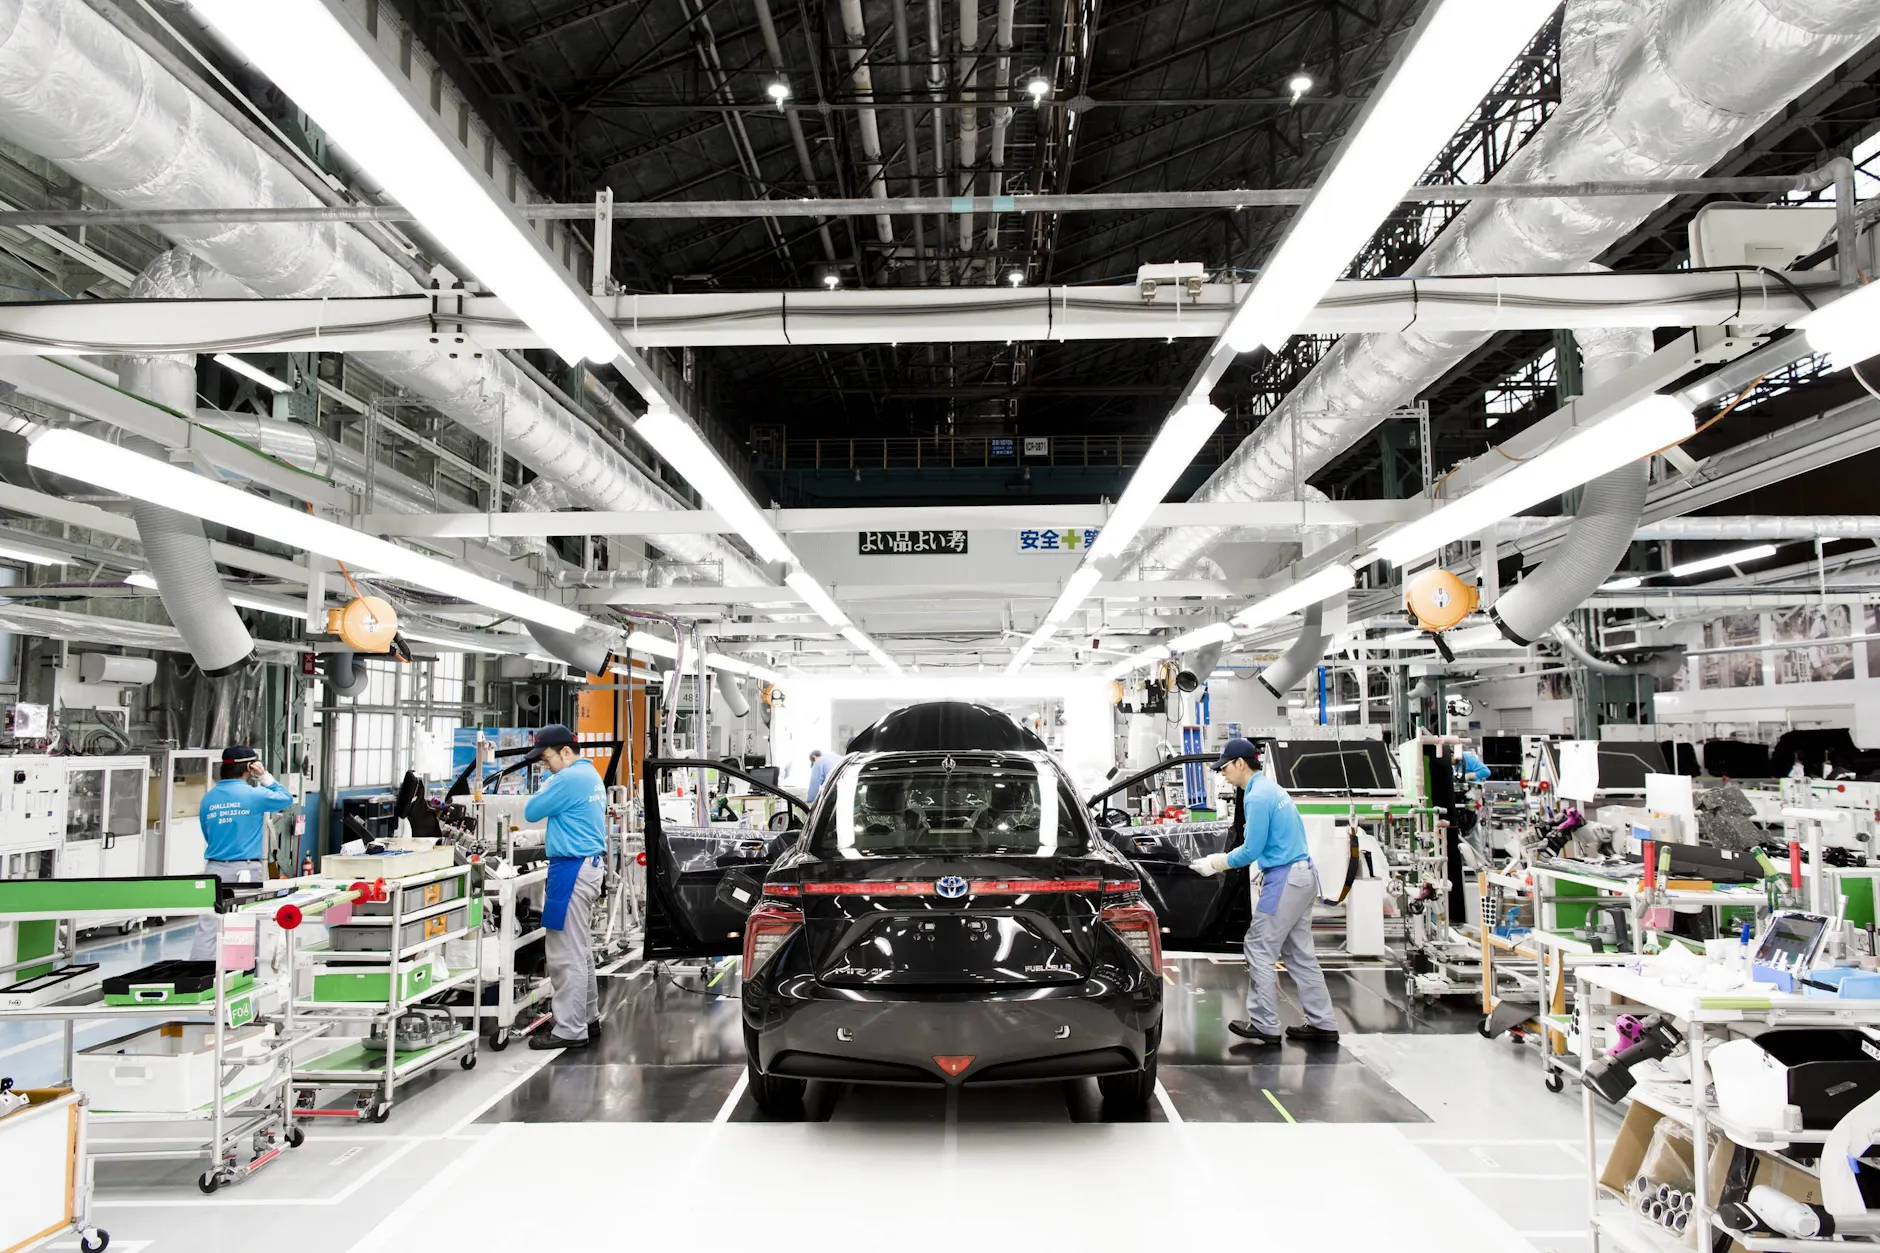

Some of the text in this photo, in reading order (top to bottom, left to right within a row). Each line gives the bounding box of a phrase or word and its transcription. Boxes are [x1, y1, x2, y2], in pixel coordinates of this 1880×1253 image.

[861, 531, 966, 552] よい品よい考
[209, 801, 242, 811] CHALLENGE
[219, 809, 251, 817] EMISSION
